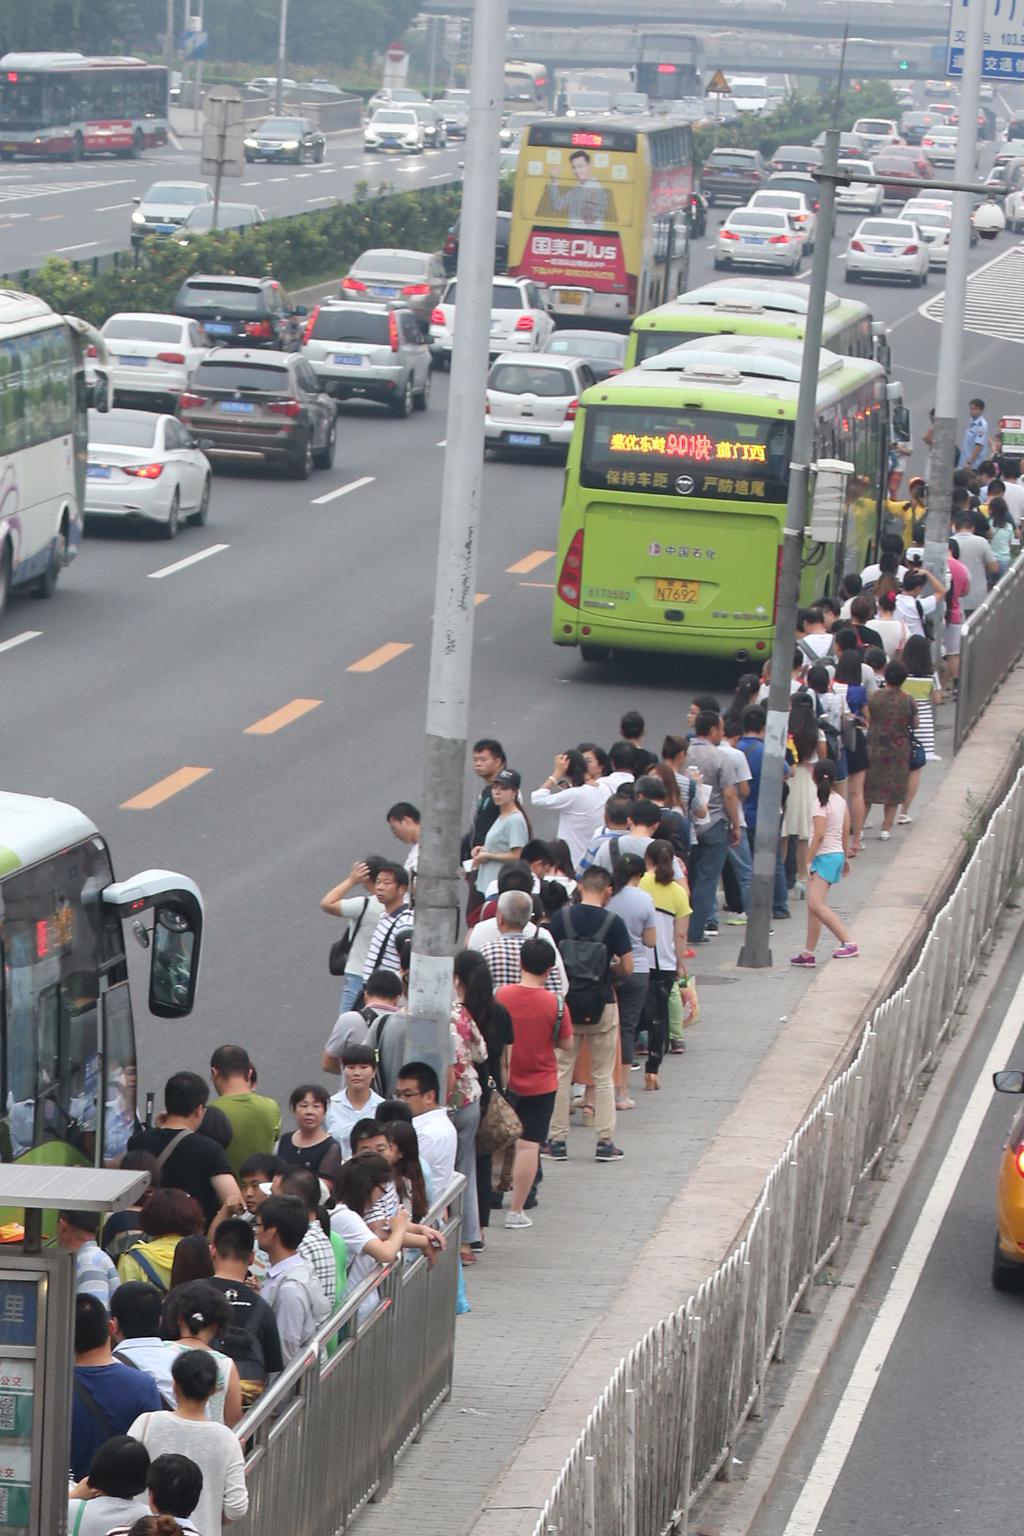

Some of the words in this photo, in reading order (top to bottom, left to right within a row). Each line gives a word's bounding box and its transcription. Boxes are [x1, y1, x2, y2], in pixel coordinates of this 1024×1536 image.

[531, 236, 617, 260] 国美Plus
[607, 470, 669, 488] 保持车距
[702, 476, 765, 497] 严防追尾
[665, 545, 716, 561] 中国石化
[657, 587, 697, 604] N7692
